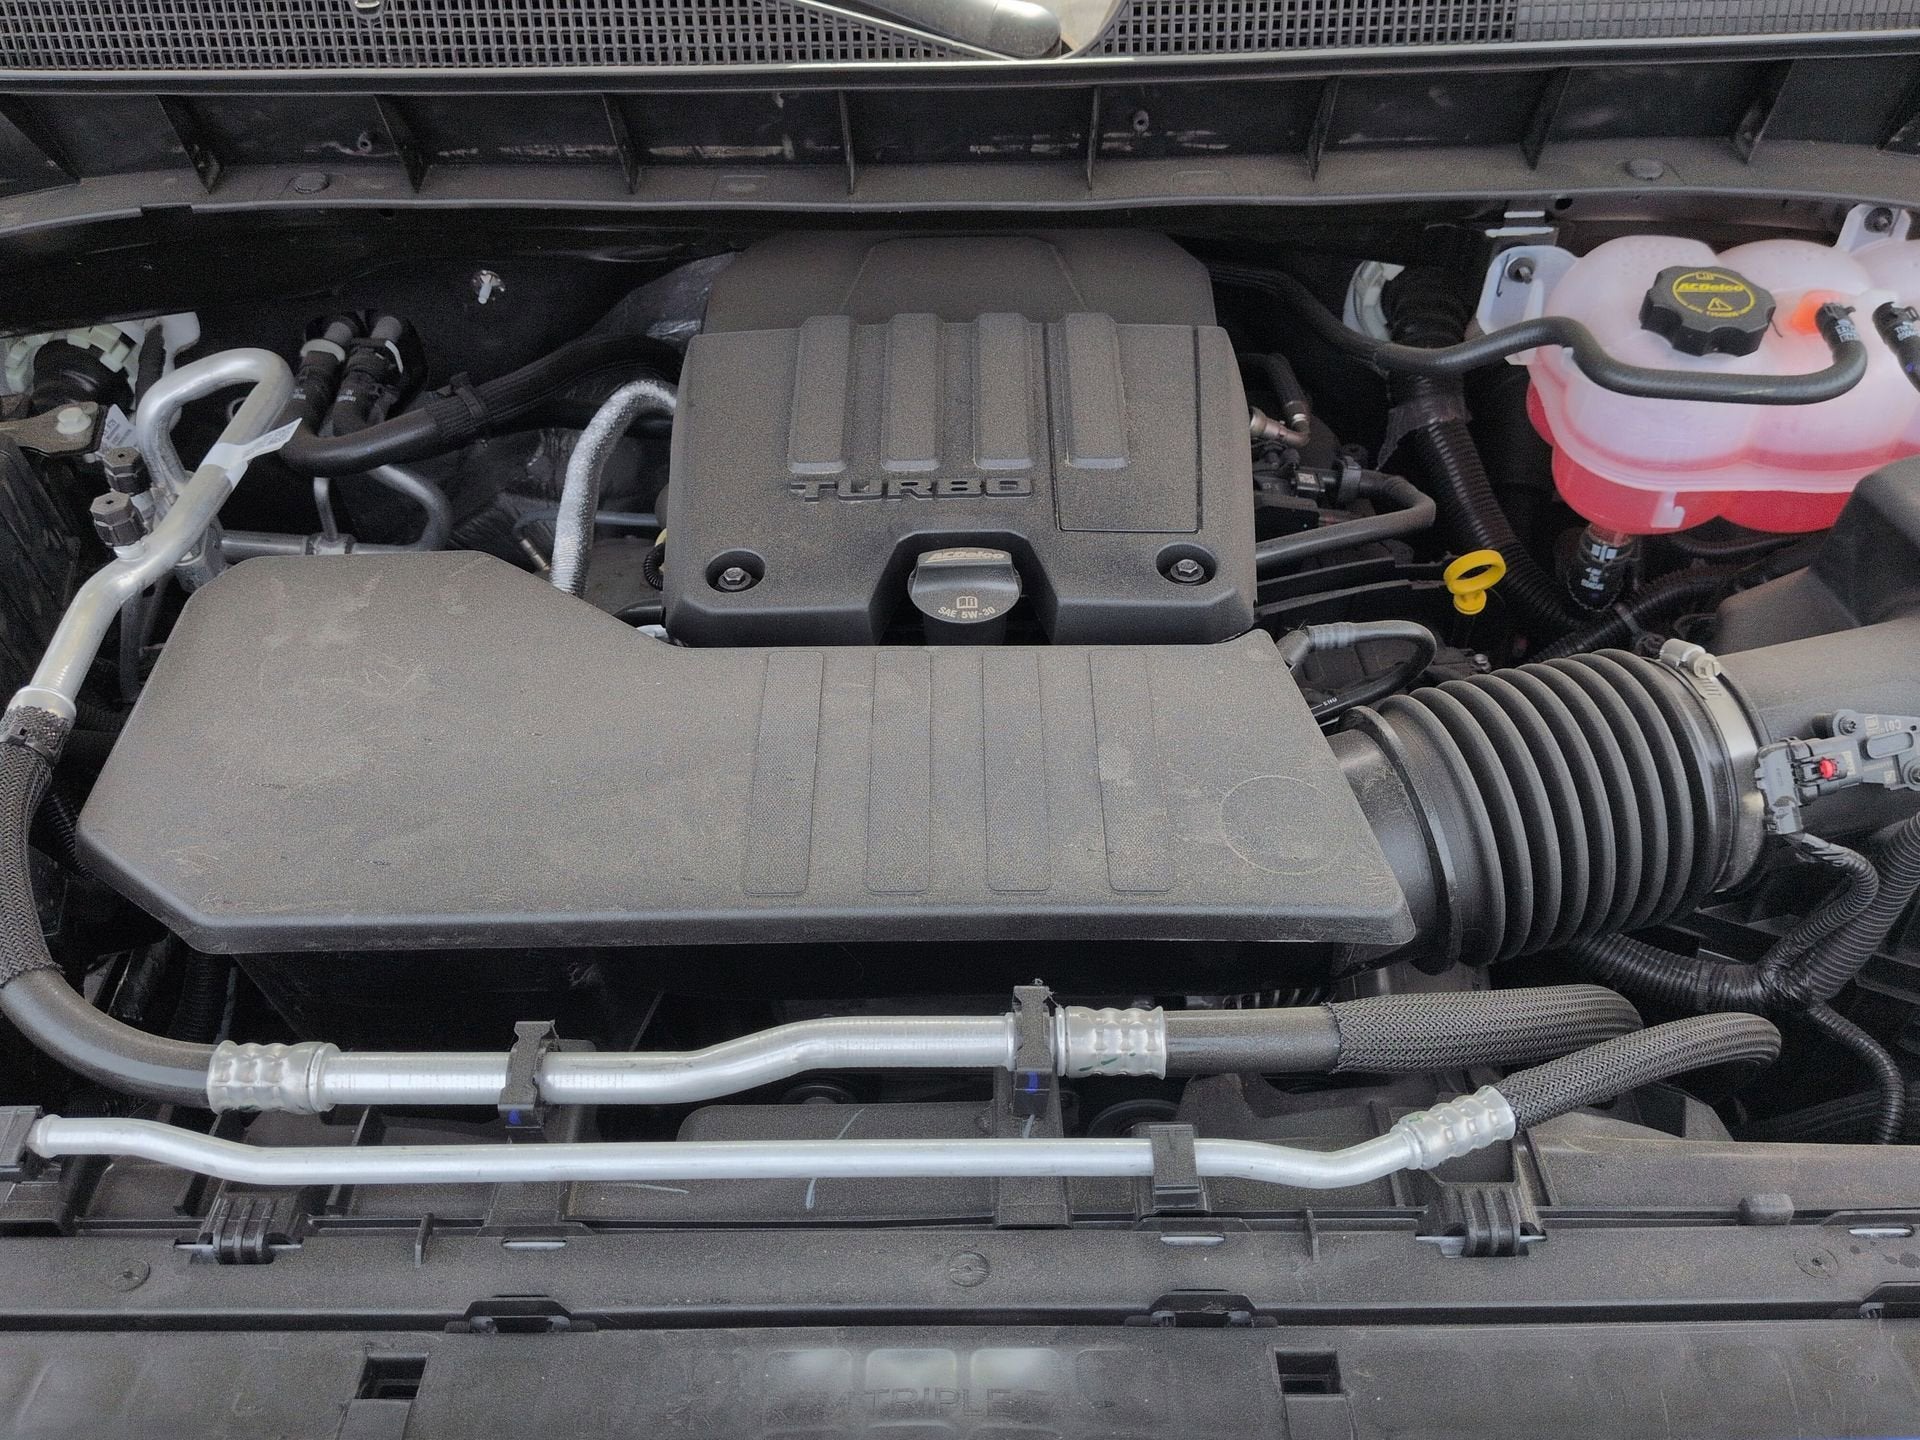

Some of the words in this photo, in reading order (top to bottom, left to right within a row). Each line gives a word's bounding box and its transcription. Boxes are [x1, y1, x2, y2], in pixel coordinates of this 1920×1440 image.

[1676, 282, 1745, 293] ACDelco
[790, 479, 1032, 502] TURBO
[925, 551, 1005, 563] ACDelco
[938, 606, 958, 618] SAE
[961, 606, 996, 619] 5W-30
